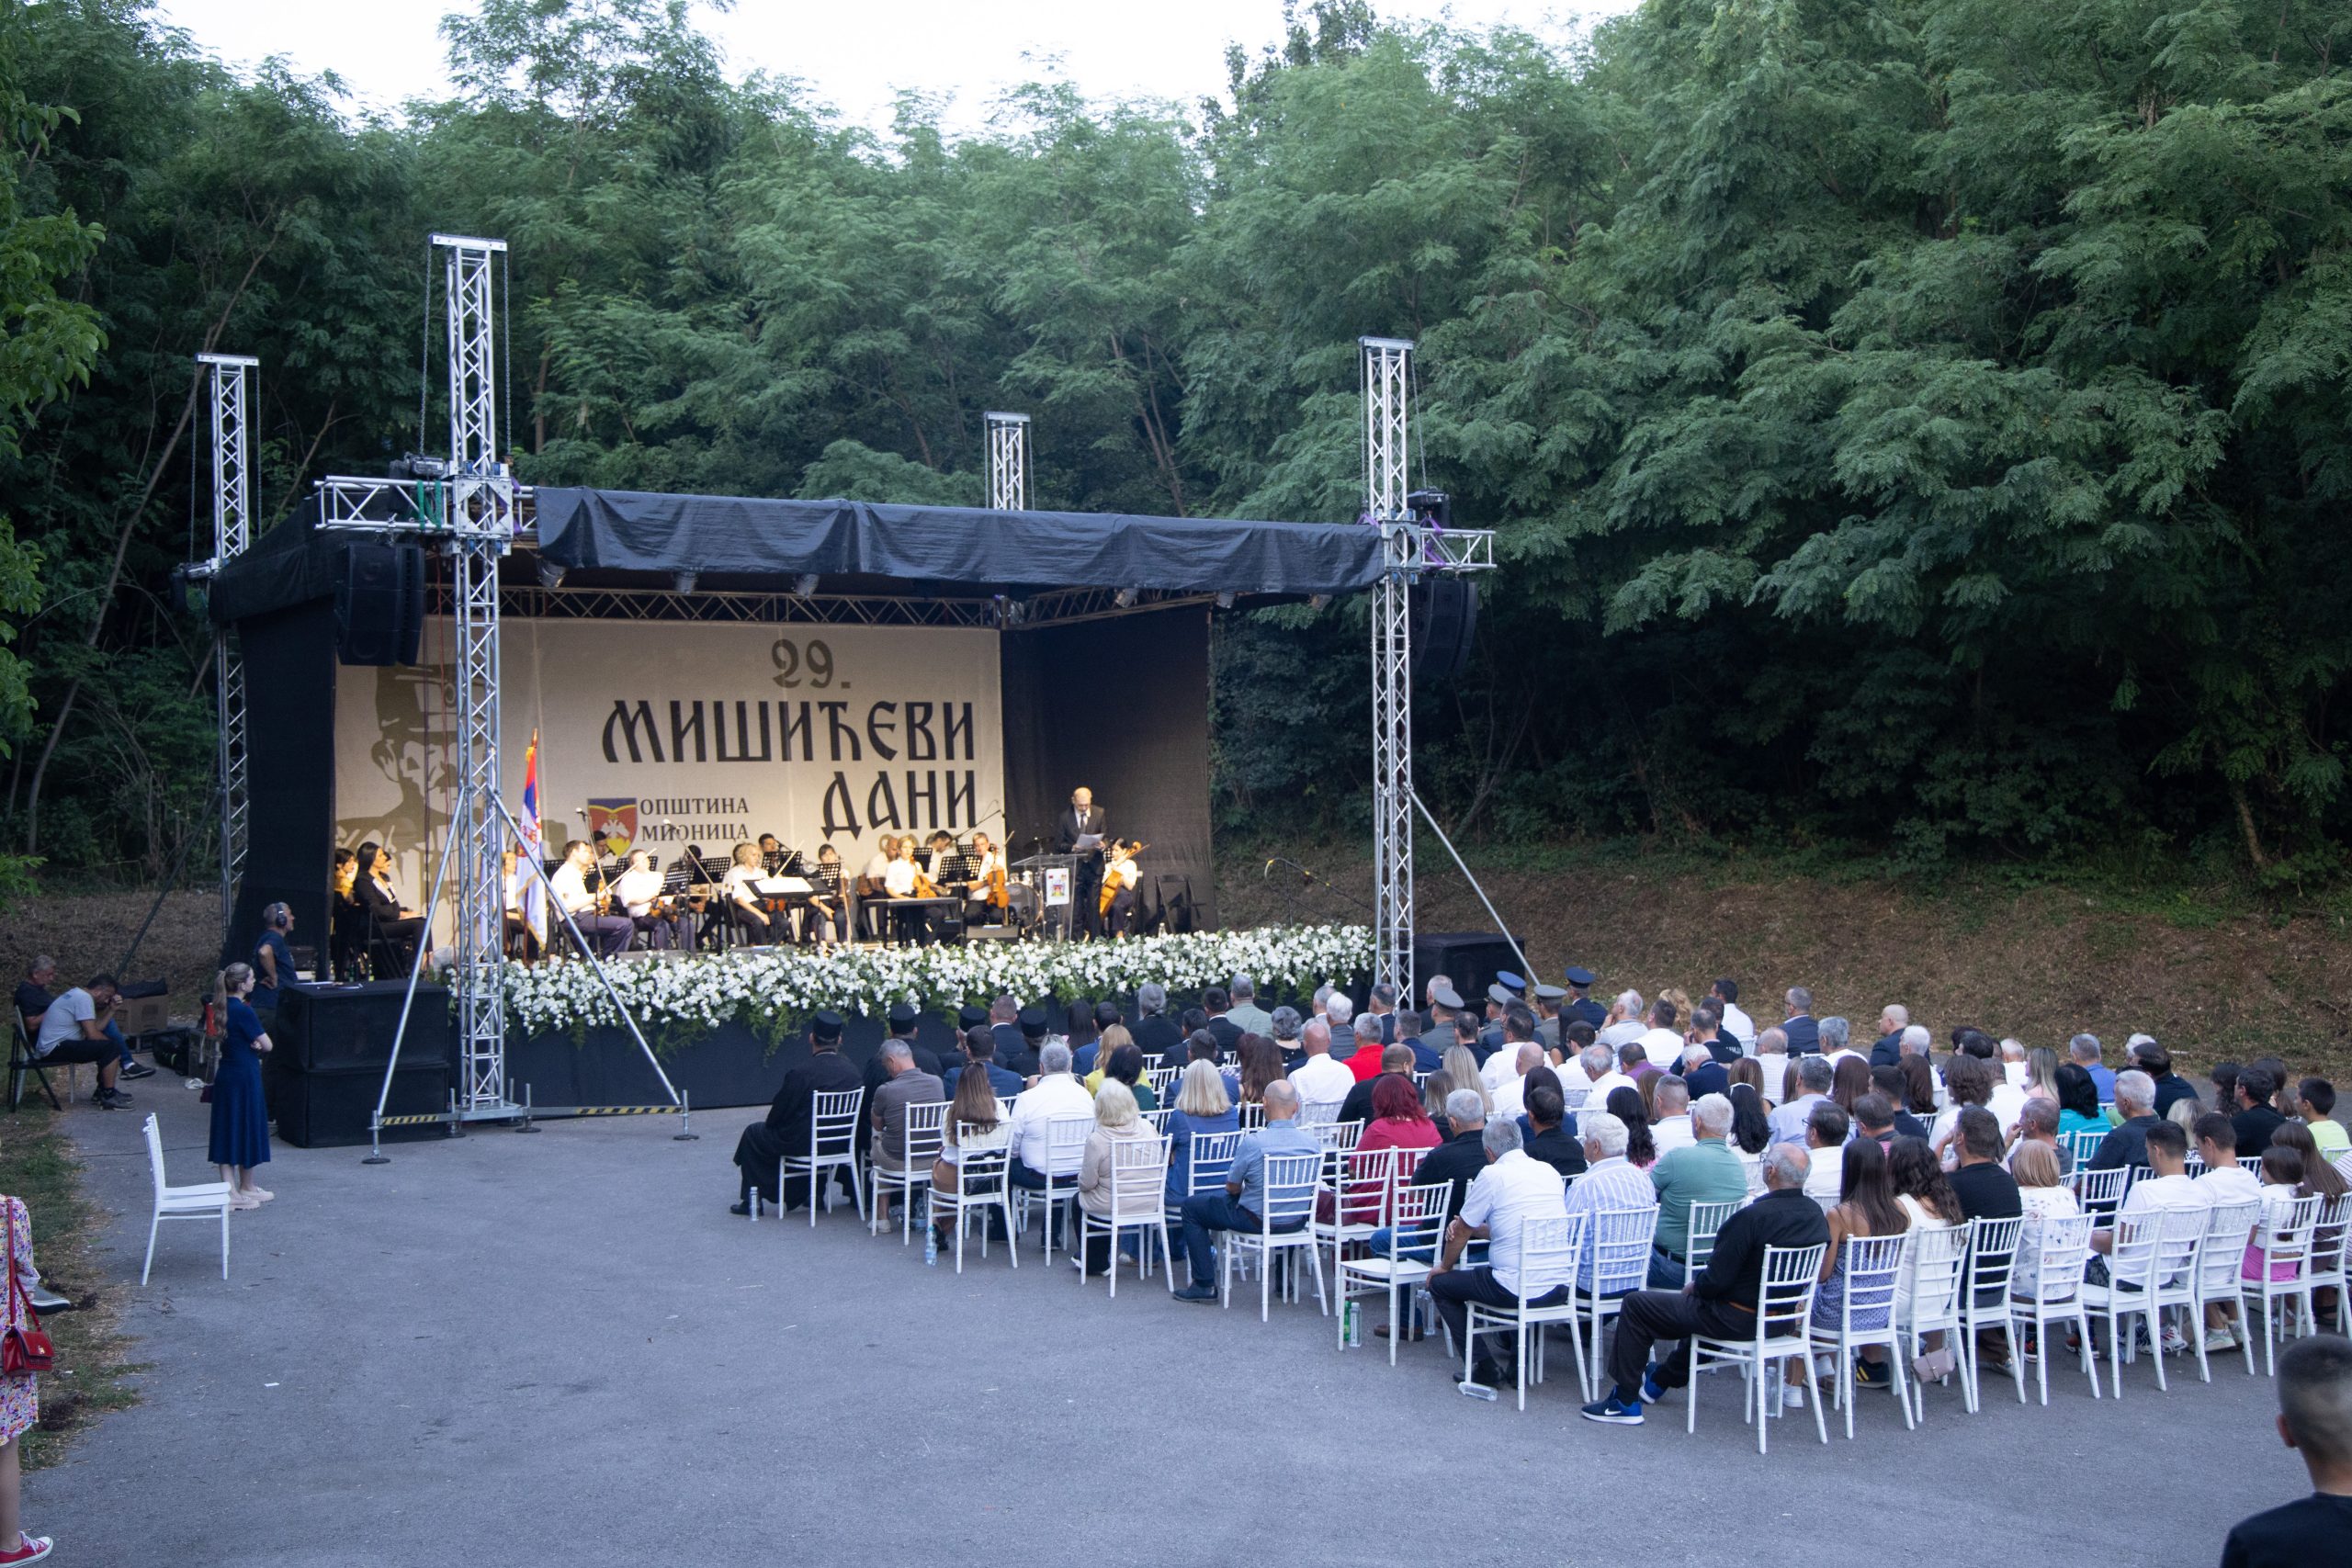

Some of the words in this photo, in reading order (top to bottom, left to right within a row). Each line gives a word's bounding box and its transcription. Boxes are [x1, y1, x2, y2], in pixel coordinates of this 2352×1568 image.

[772, 638, 852, 690] 29.
[639, 797, 750, 816] ОПШТИНА
[820, 769, 978, 841] ДАНИ
[641, 823, 750, 842] МИОНИЦА
